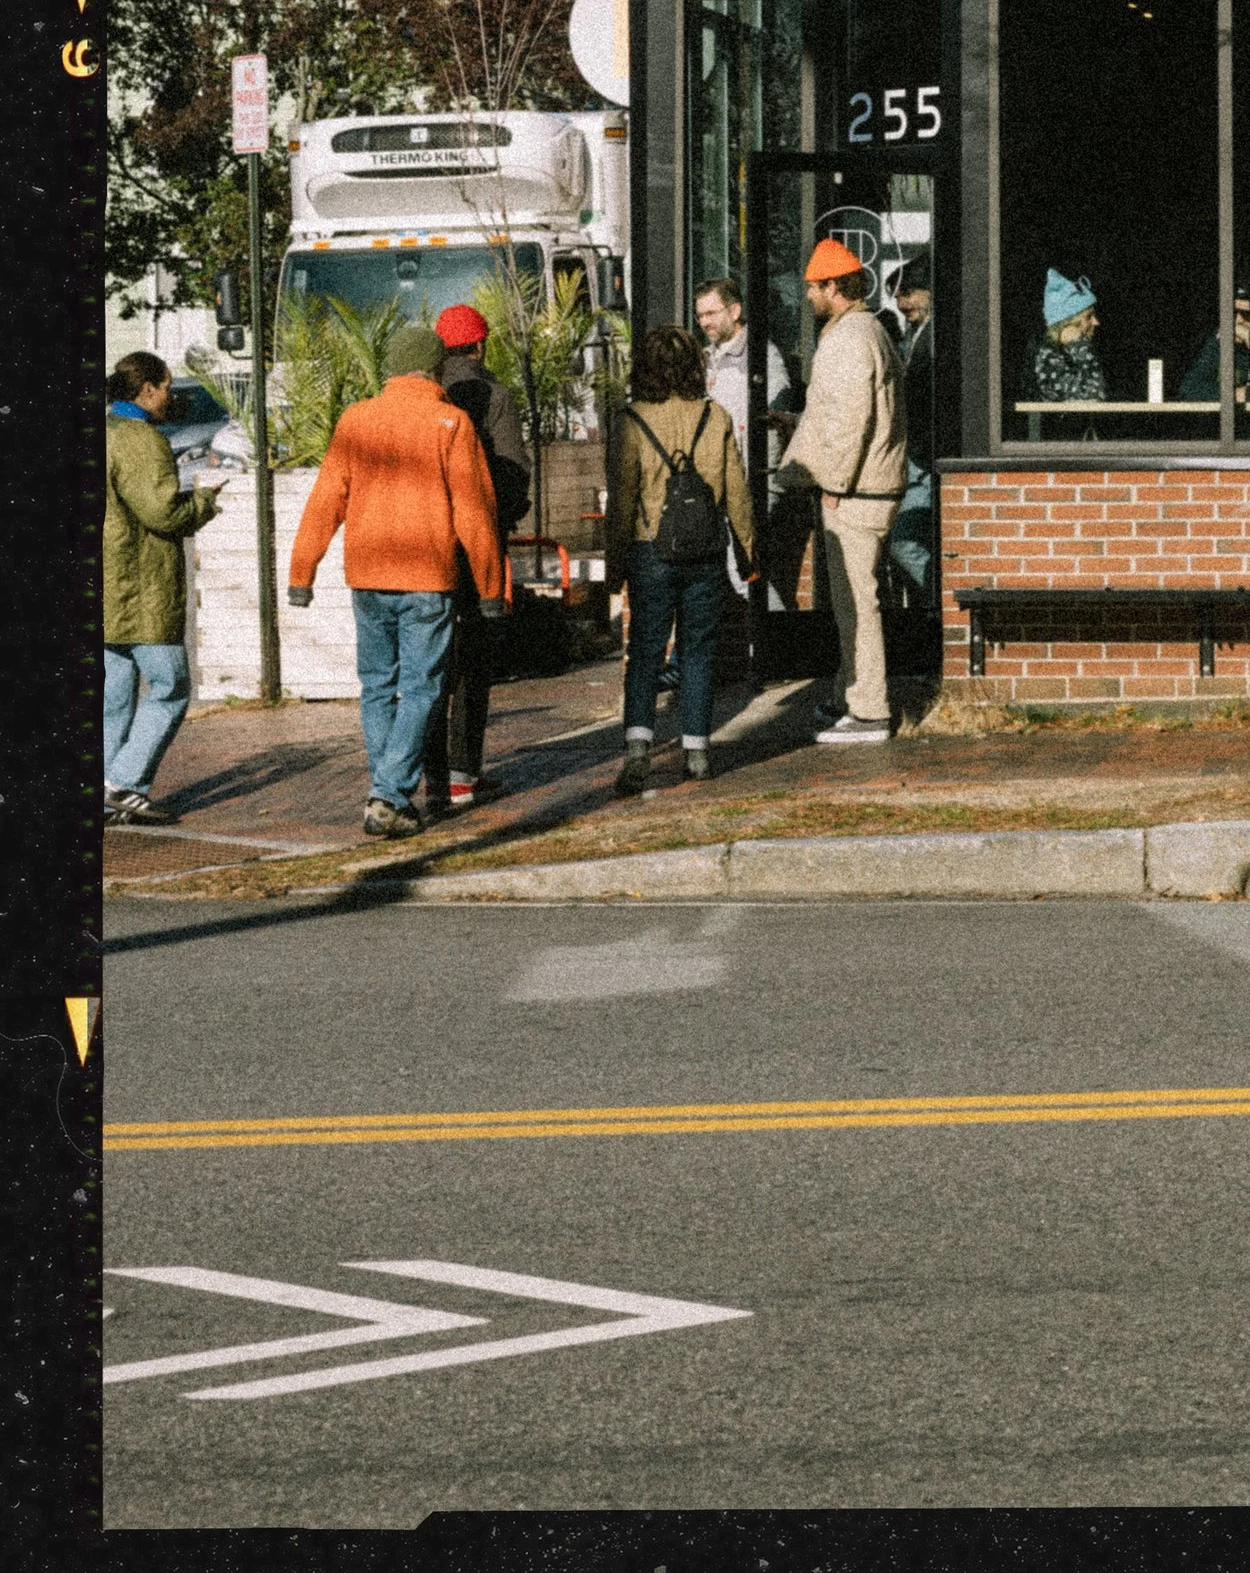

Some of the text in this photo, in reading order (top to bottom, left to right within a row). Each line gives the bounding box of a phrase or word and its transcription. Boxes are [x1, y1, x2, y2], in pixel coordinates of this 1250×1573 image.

[849, 86, 942, 142] 255
[371, 149, 468, 165] THERMO KING
